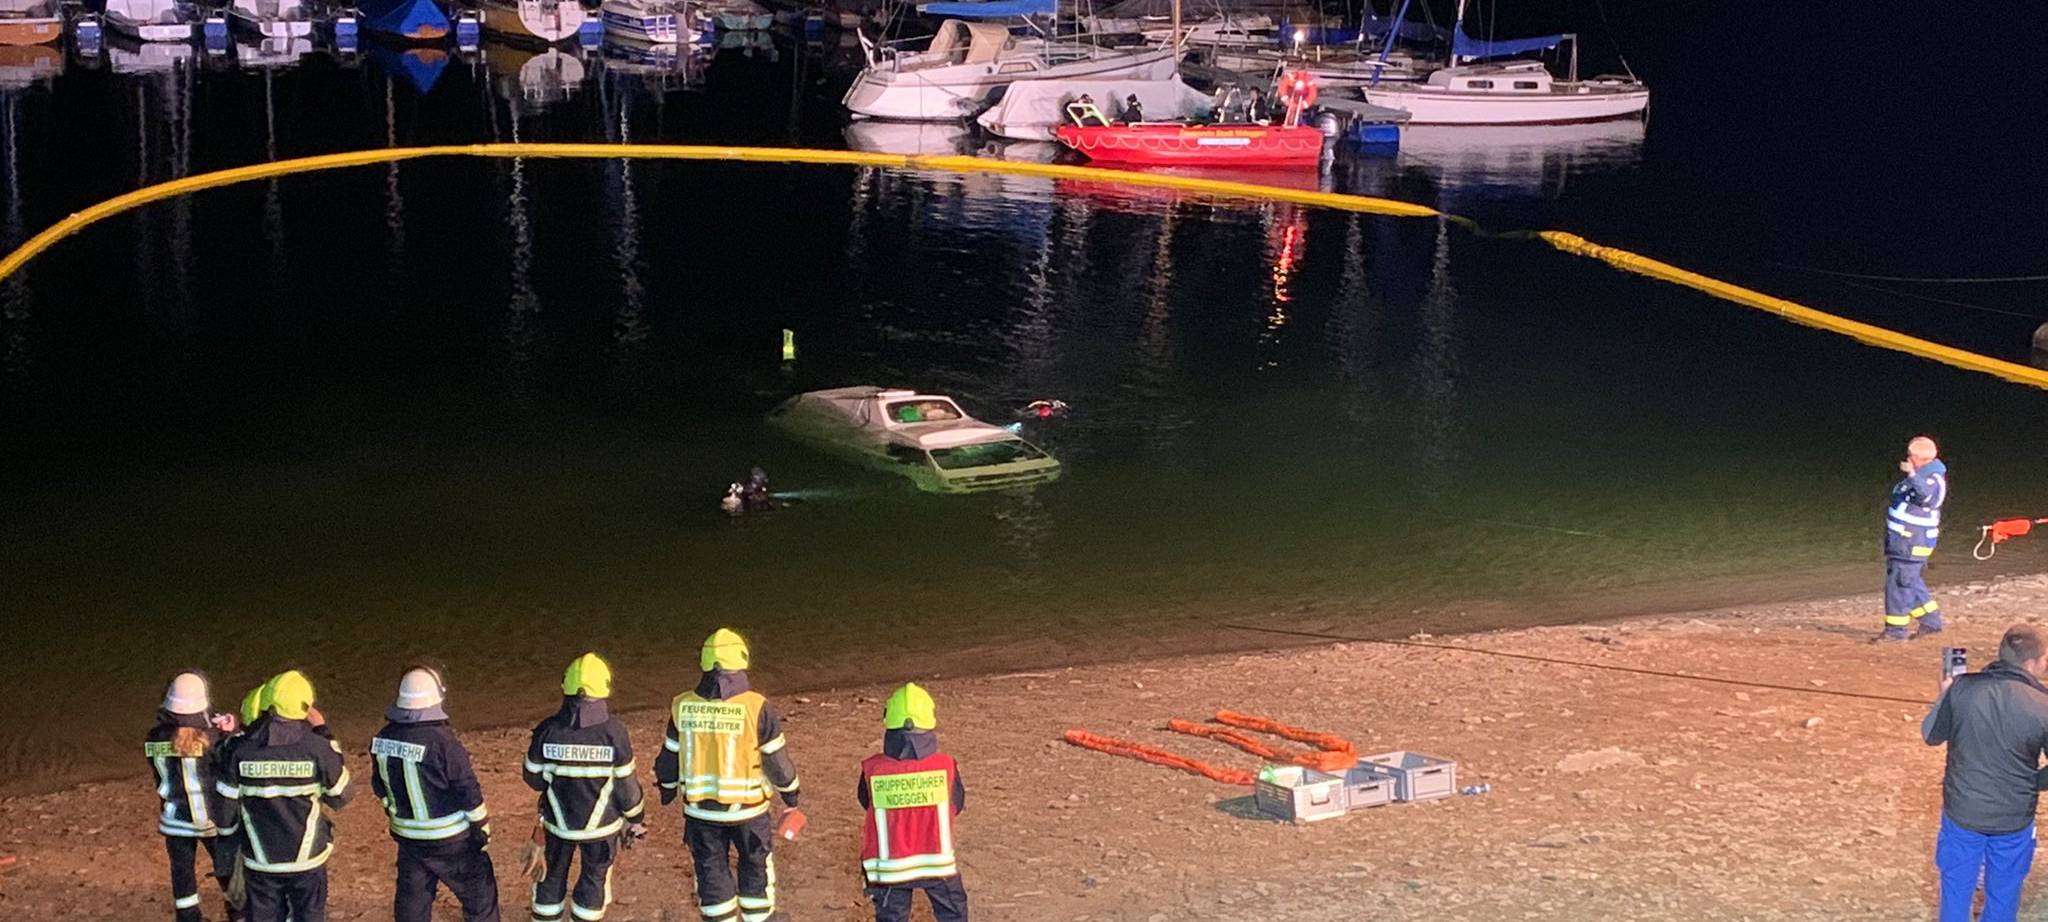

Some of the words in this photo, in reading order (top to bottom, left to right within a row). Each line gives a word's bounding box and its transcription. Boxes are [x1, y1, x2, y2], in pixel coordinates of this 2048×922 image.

[681, 704, 742, 715] FEUERWEHR
[545, 745, 611, 760] FEUERWEHR
[241, 763, 311, 776] FEUERWEHR
[873, 775, 945, 792] GRUPPENFÜHRER
[886, 791, 928, 806] NIDEGGEN
